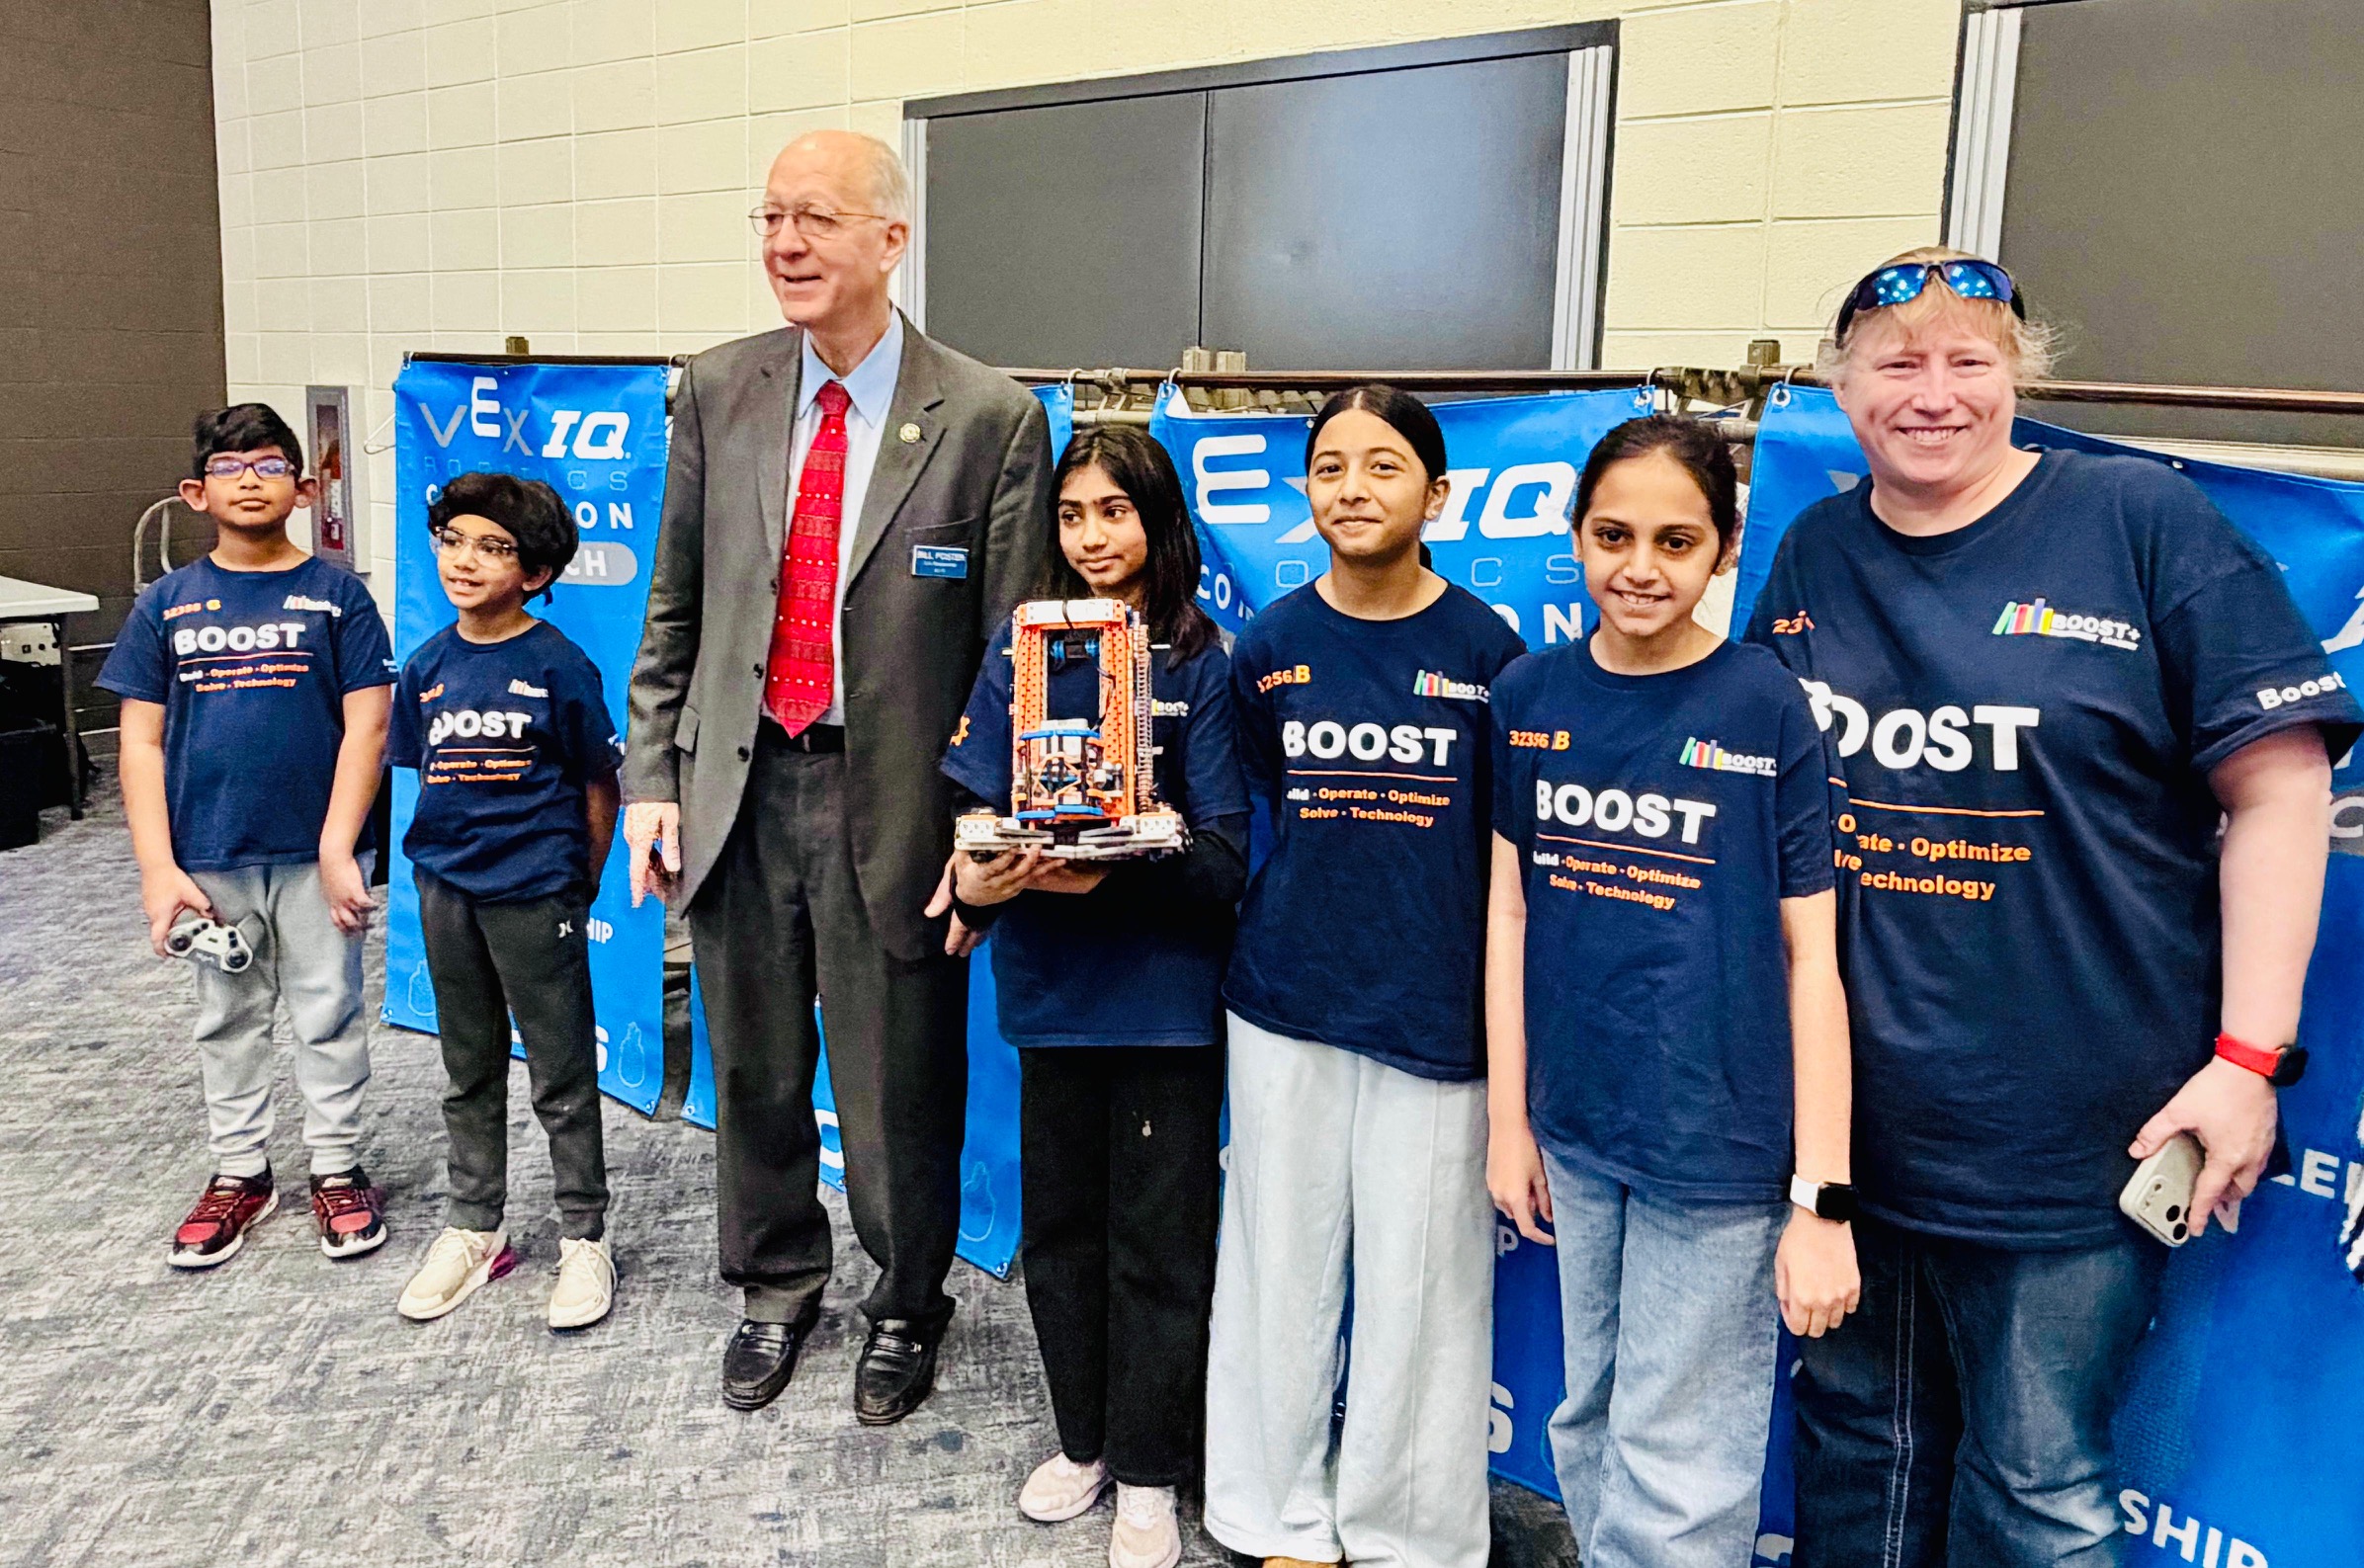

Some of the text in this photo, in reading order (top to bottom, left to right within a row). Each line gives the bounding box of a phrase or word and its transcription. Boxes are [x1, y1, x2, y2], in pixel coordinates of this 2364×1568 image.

[418, 376, 631, 460] VEX IQ
[1420, 461, 1577, 541] IQ
[174, 622, 306, 656] BOOST
[1283, 719, 1457, 767] BOOST
[1318, 787, 1378, 801] Operate
[1388, 789, 1451, 806] Optimize
[1536, 779, 1717, 845] BOOST
[1300, 806, 1434, 828] Solve Technology
[1910, 837, 2032, 863] Optimize
[1627, 865, 1702, 889] Optimize
[1860, 870, 1996, 901] echnology
[1585, 880, 1676, 911] Technology
